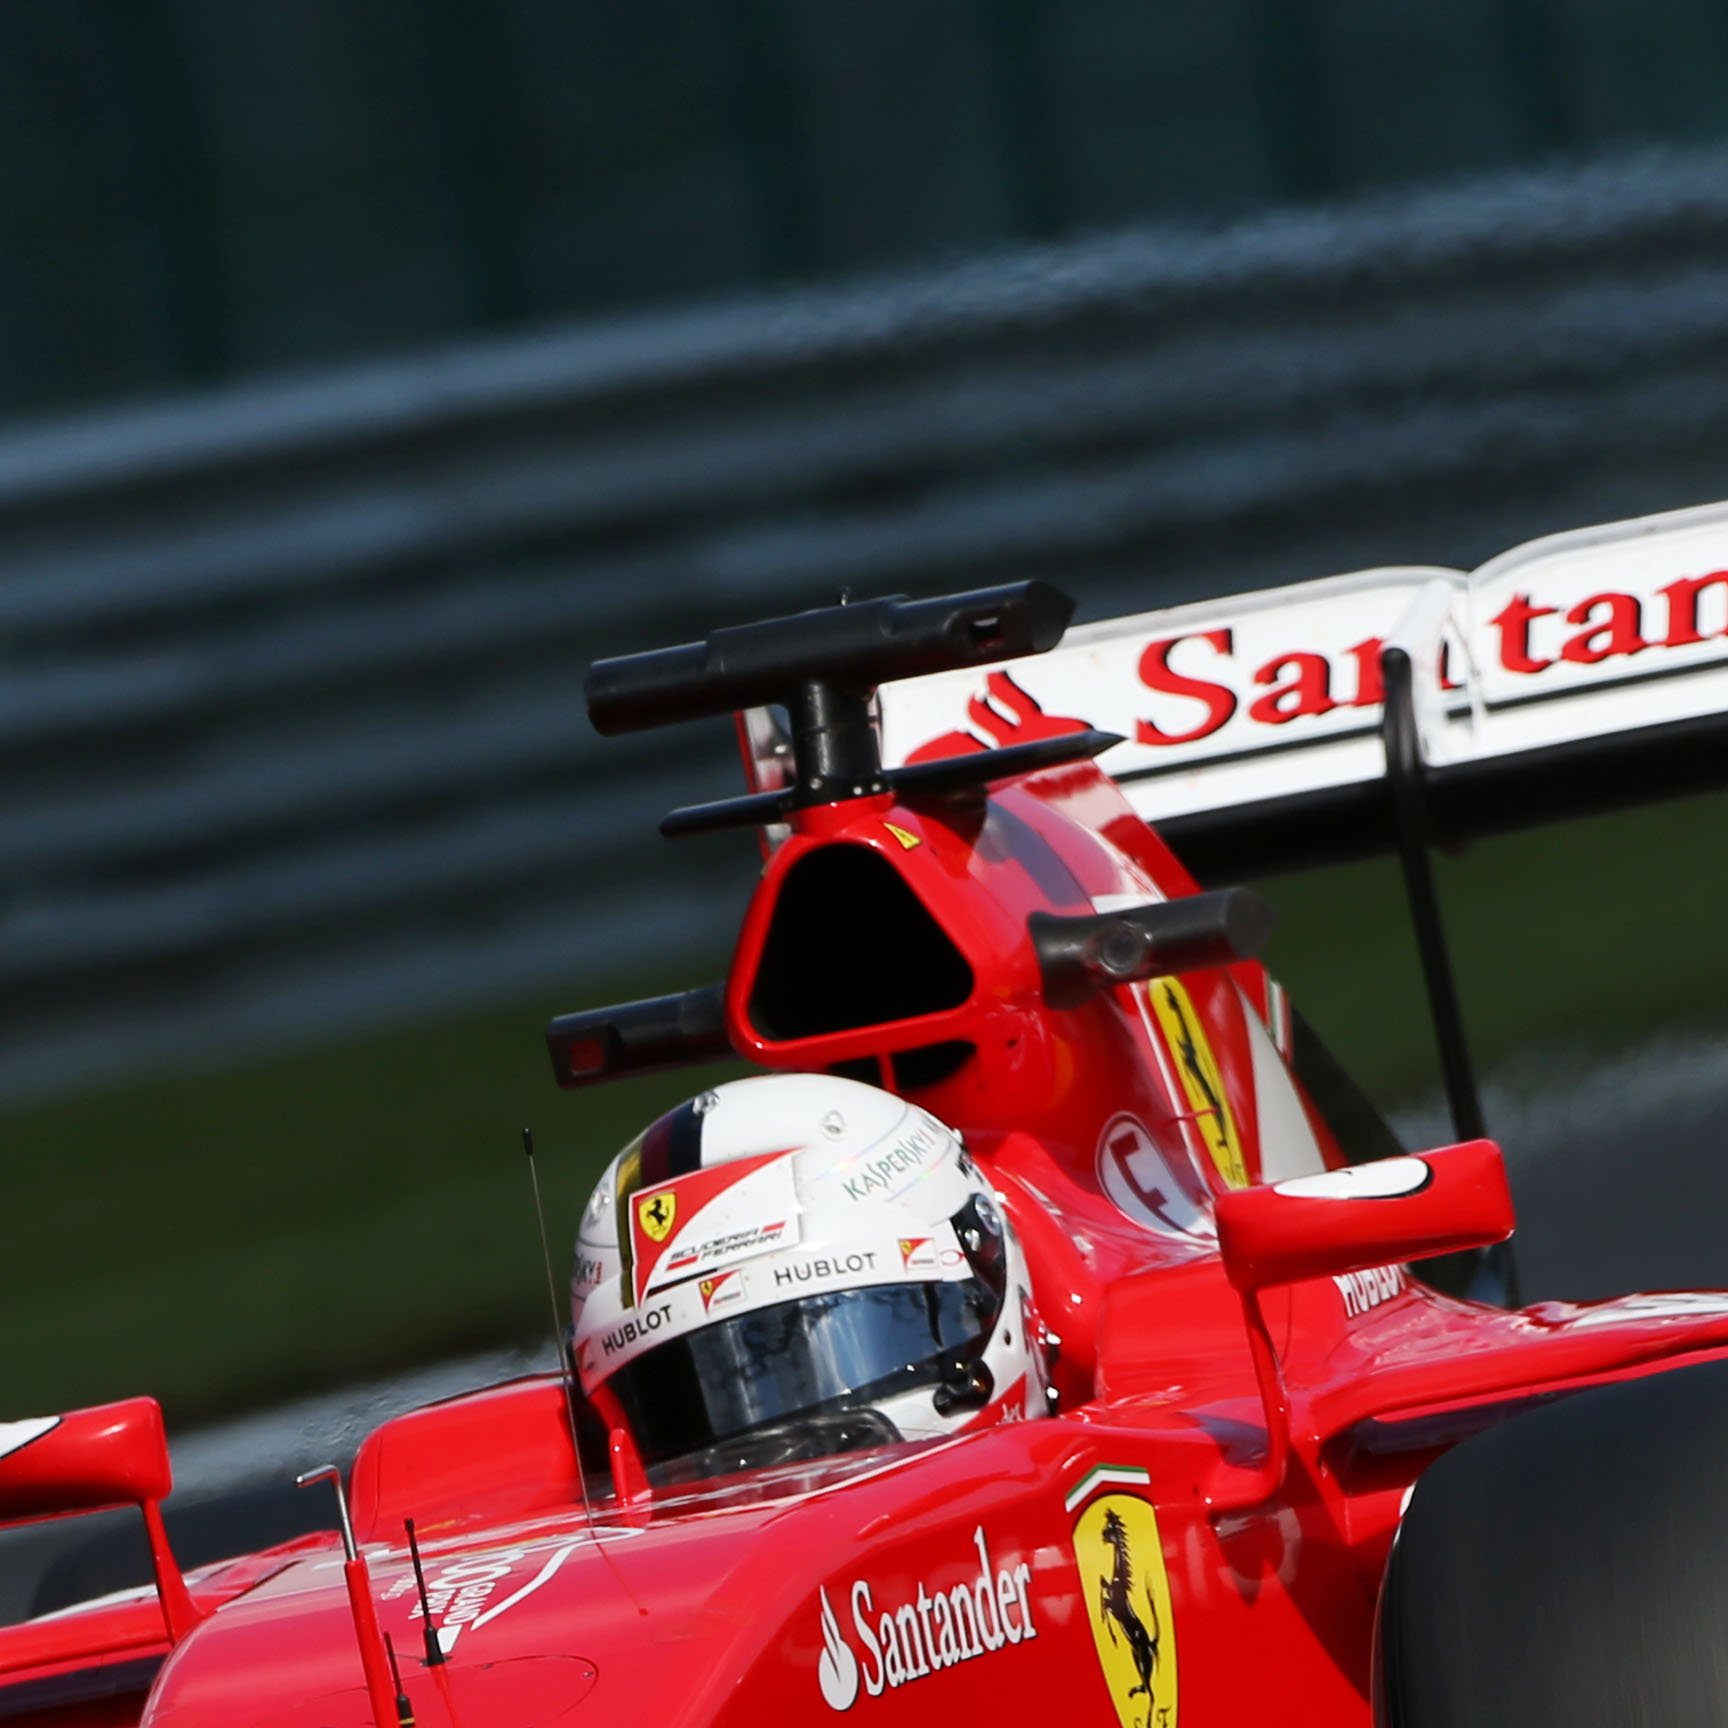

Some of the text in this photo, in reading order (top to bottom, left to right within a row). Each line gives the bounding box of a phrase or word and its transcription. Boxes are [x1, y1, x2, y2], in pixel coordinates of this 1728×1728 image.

[774, 1252, 877, 1287] HUBLOT
[602, 1304, 672, 1356] HUBLOT
[851, 1525, 1037, 1697] Santander
